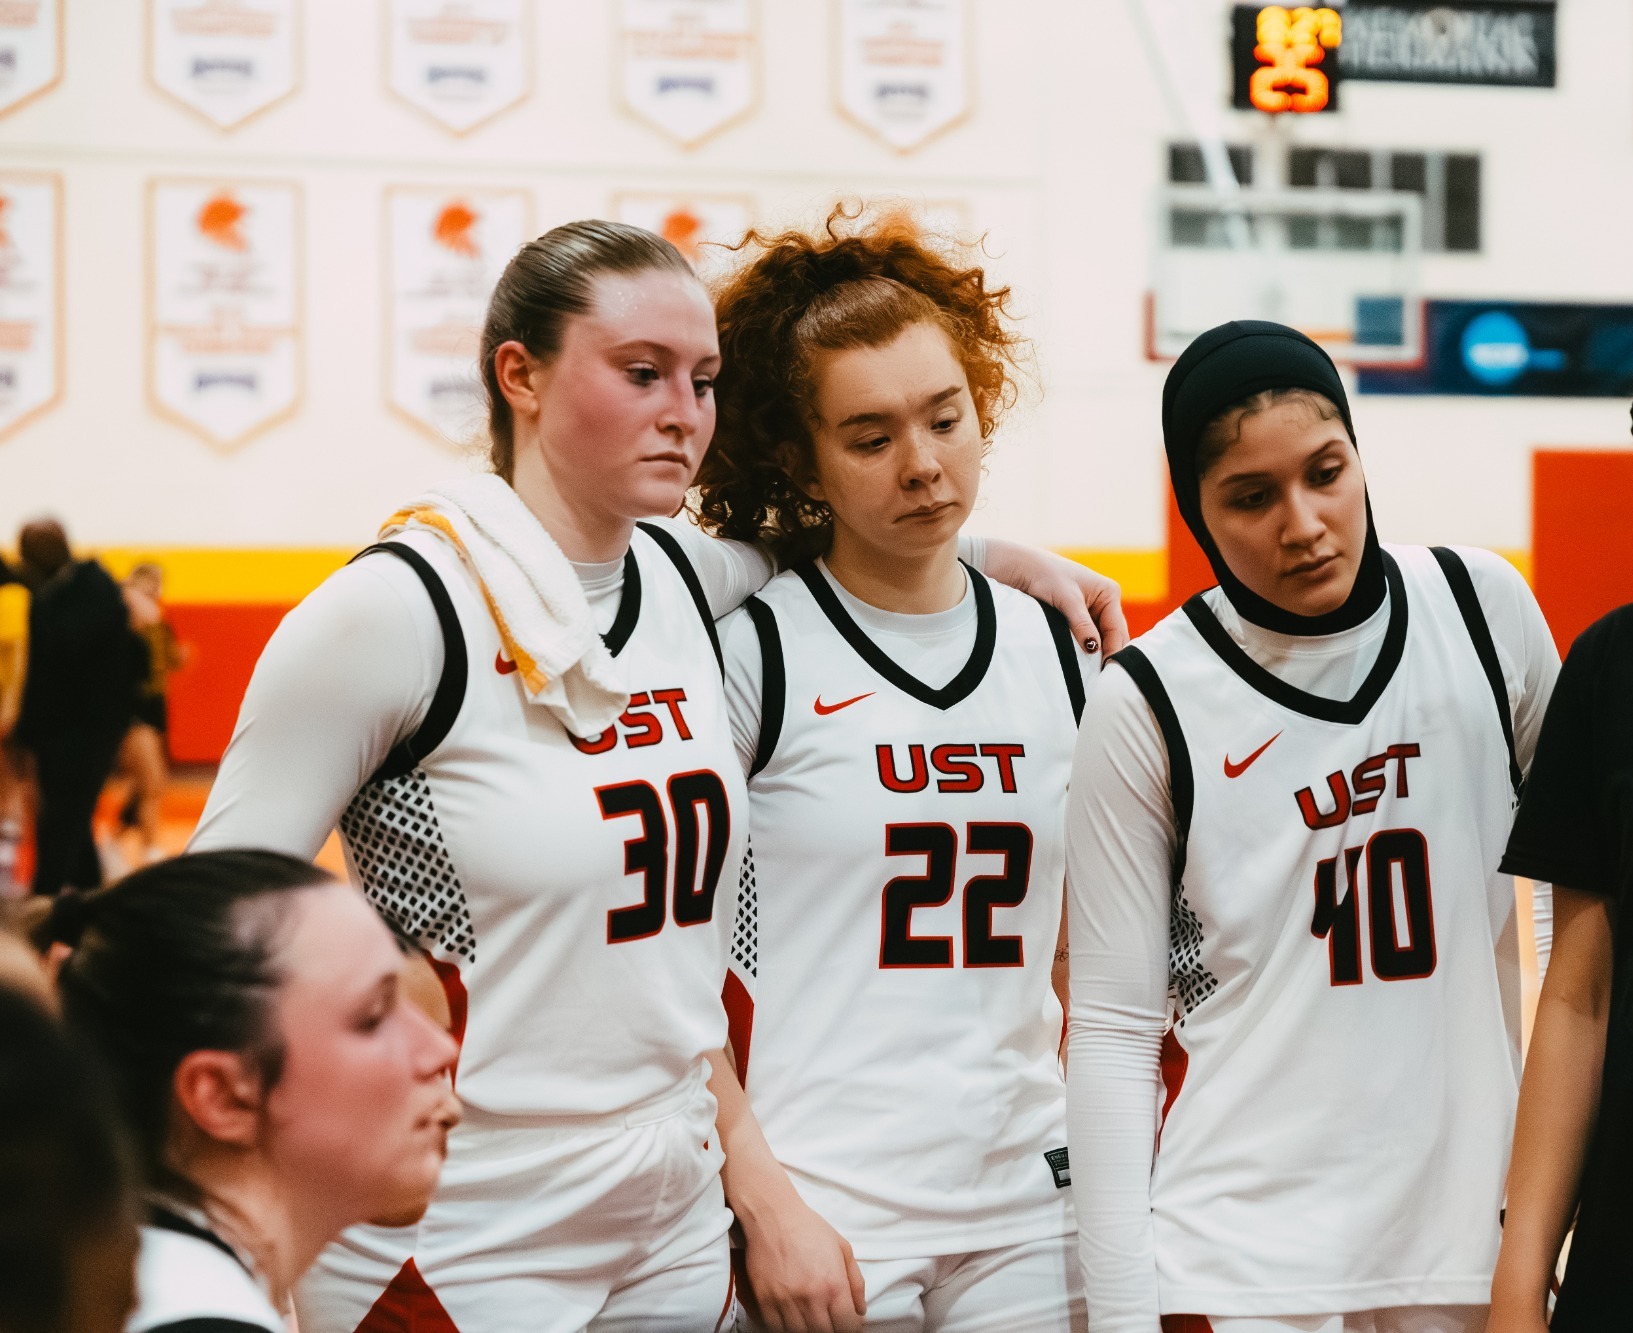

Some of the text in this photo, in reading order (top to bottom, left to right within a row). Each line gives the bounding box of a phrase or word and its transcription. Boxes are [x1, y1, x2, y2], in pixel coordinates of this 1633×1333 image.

[875, 743, 1026, 793] UST
[1293, 742, 1421, 831] UST
[593, 768, 731, 945] 30
[878, 821, 1034, 970] 22
[1310, 827, 1438, 987] 40
